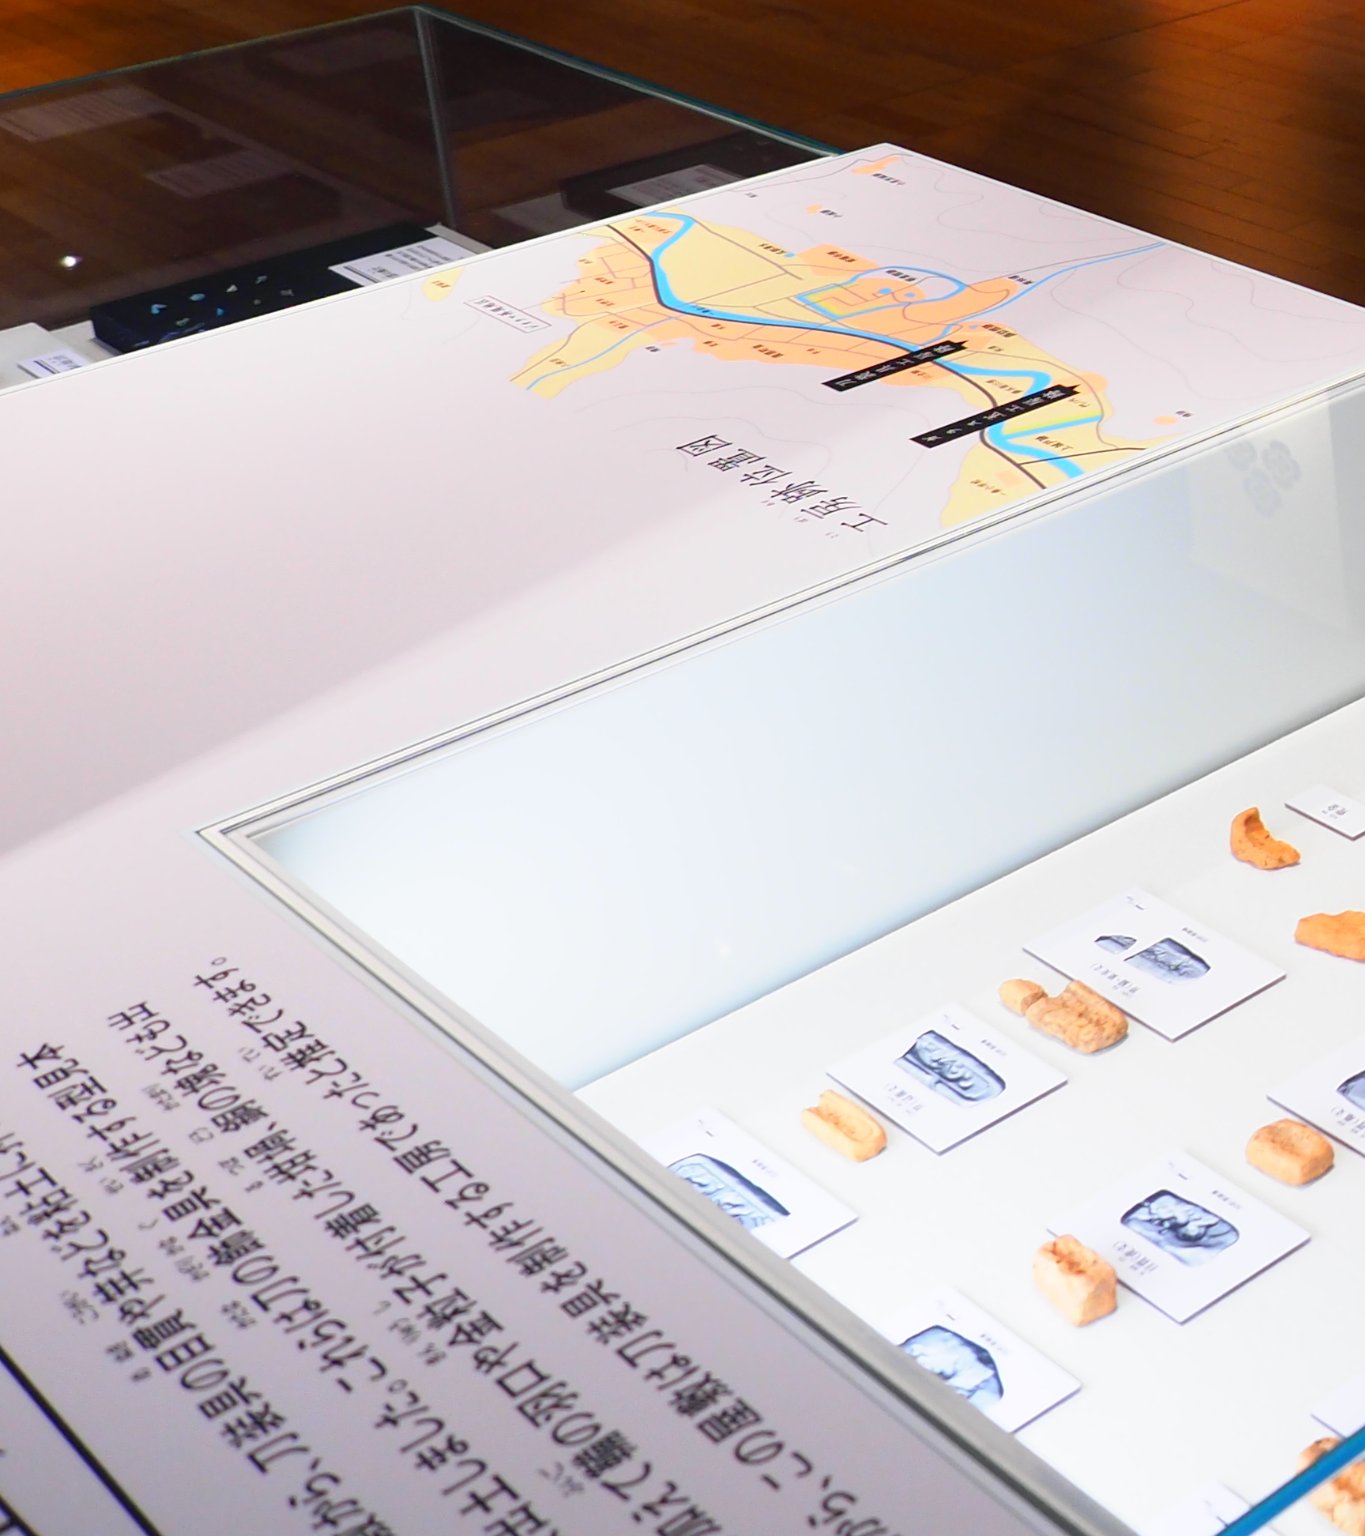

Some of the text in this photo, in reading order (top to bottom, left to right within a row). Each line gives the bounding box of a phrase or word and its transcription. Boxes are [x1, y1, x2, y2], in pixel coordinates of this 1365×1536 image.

[675, 434, 888, 532] 工房跡位置図
[19, 1042, 560, 1536] 出土しました。これらは刀の飾金具を制作する型見本
